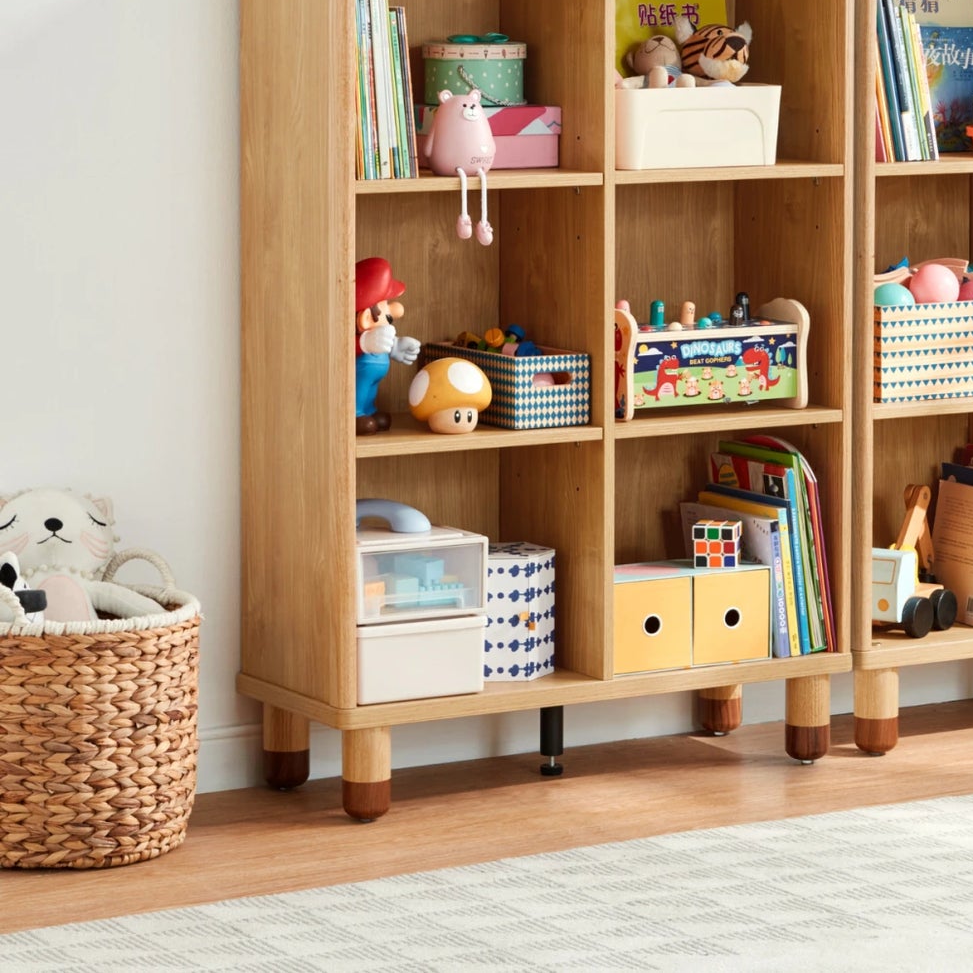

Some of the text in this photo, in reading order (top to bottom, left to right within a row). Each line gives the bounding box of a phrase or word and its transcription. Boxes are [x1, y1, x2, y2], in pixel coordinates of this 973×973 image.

[638, 3, 699, 26] 贴纸书
[680, 340, 742, 359] DINOSAURS
